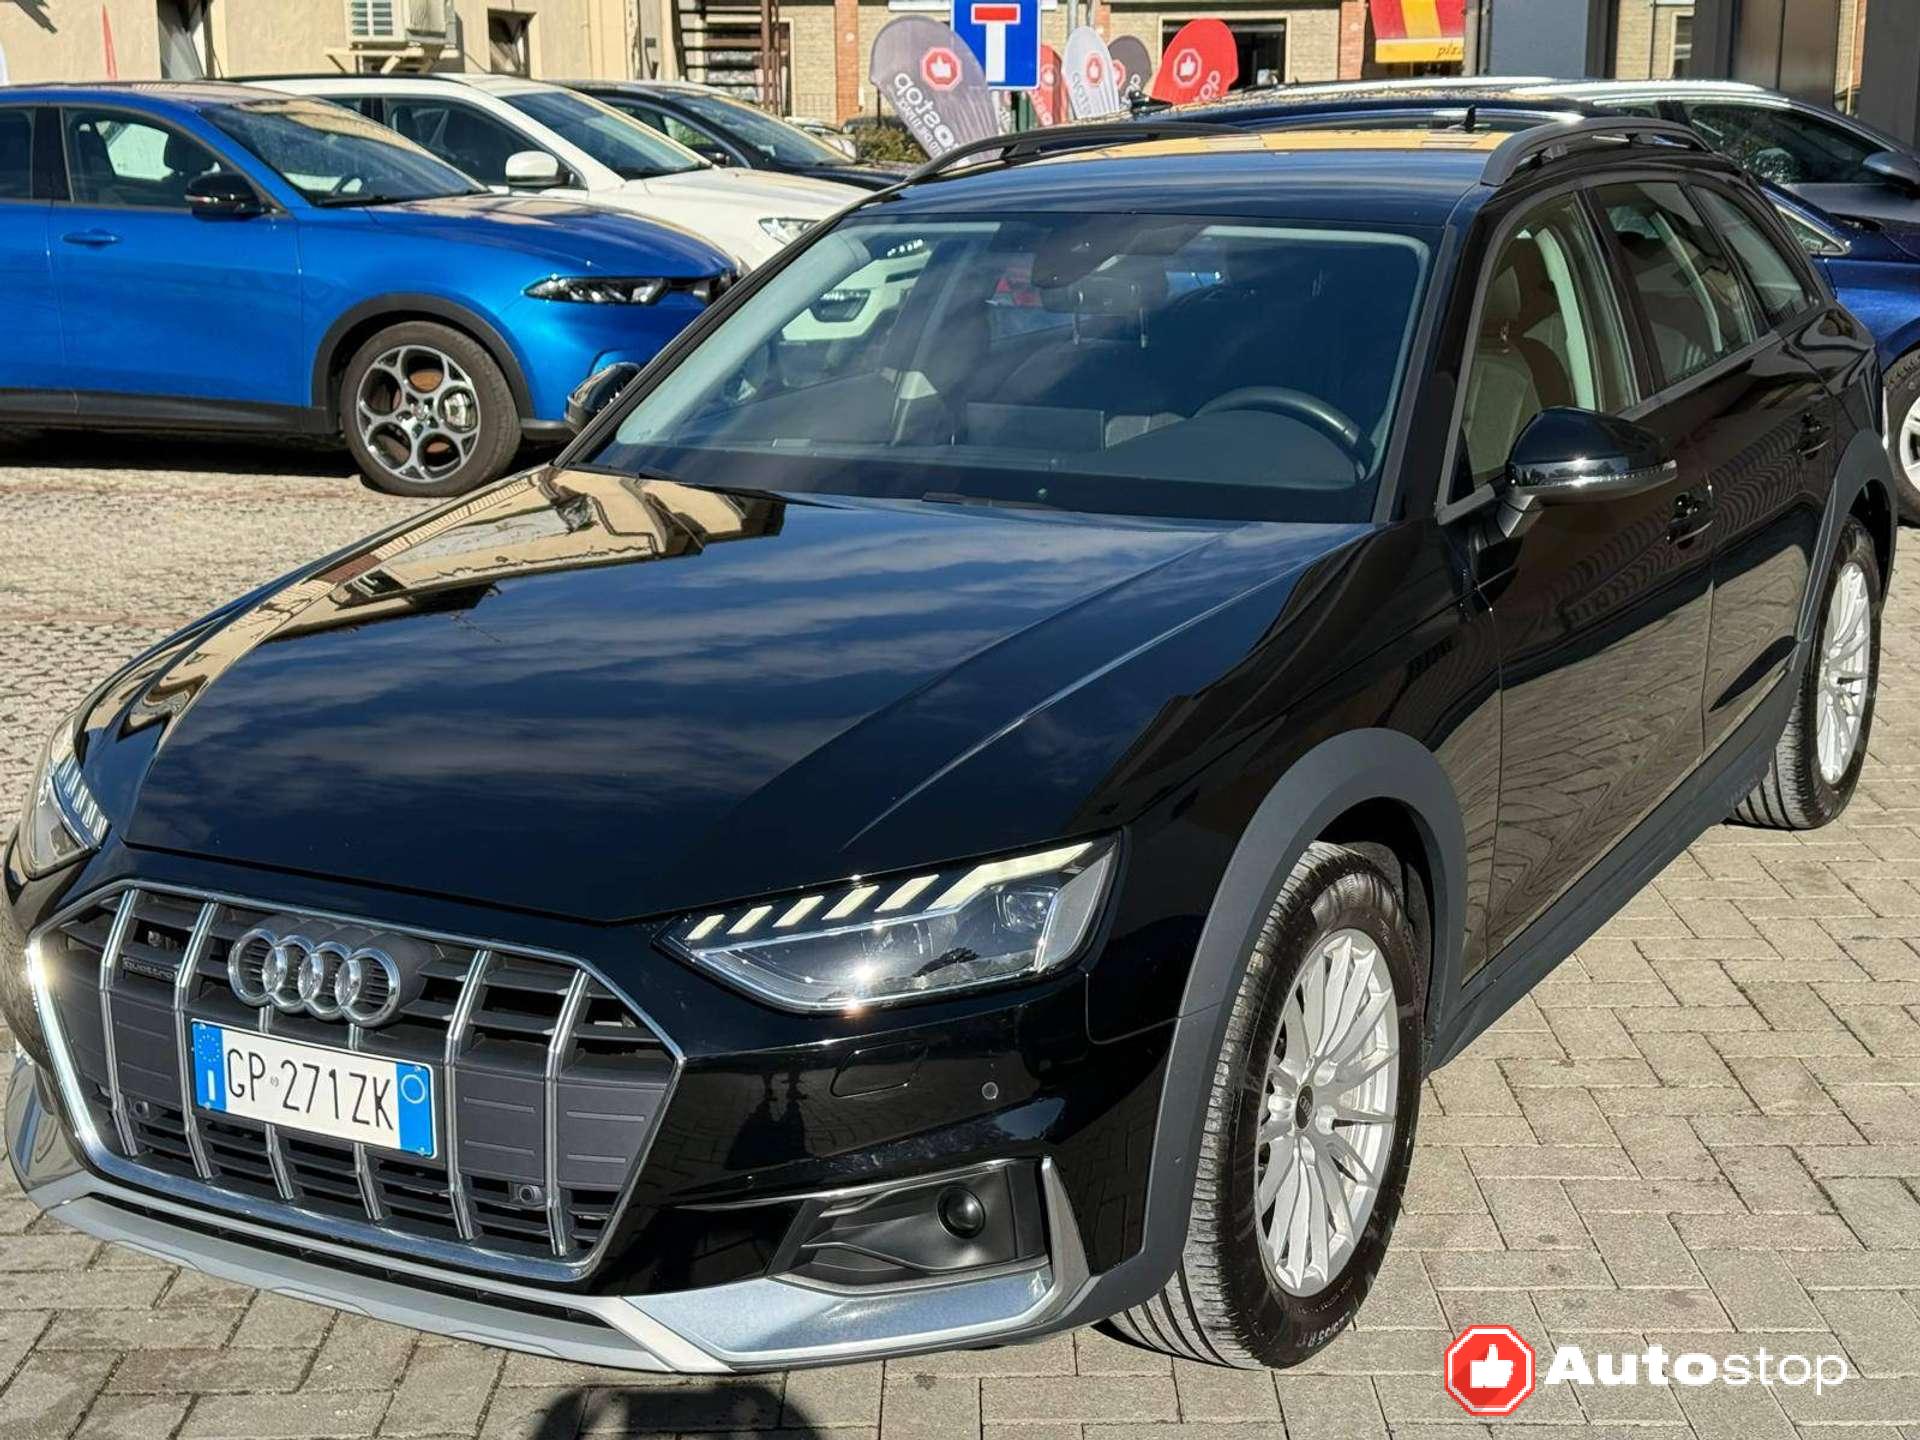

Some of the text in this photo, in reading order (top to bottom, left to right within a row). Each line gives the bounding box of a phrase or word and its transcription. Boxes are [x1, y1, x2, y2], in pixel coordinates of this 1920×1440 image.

[1435, 42, 1462, 59] piz
[227, 1048, 393, 1130] GP 271ZK
